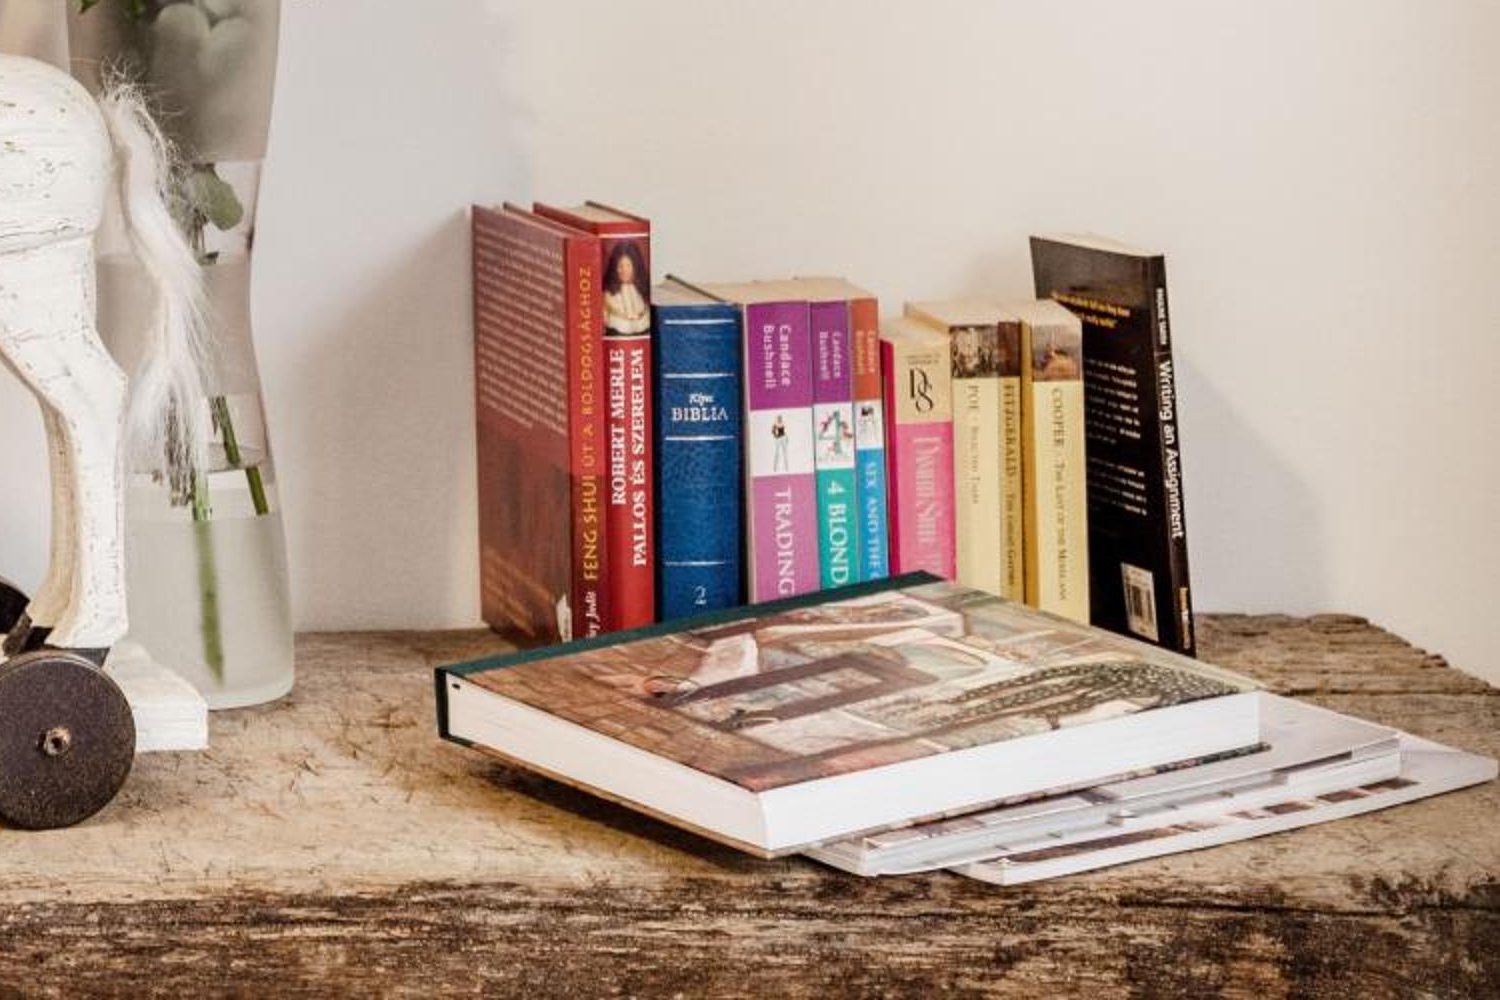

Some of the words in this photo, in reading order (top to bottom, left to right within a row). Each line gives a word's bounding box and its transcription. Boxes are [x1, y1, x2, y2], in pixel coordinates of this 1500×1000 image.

[578, 267, 594, 415] BOLDOGSÁGHOZ
[763, 325, 777, 389] Bushnell
[780, 325, 792, 387] Candace
[609, 349, 625, 419] MERLE
[631, 348, 645, 455] SZERELEM
[672, 407, 728, 421] BIBLIA
[1159, 360, 1175, 421] Writing
[583, 423, 593, 437] A
[1163, 423, 1175, 444] an
[611, 423, 626, 504] ROBERT
[629, 459, 645, 485] ÉS
[827, 480, 846, 495] 4
[1165, 449, 1184, 538] Assignment
[581, 475, 597, 523] SHUI
[632, 491, 647, 566] PALLOS
[867, 498, 879, 533] AND
[583, 529, 598, 580] FENG
[774, 486, 795, 595] TRADING
[828, 503, 849, 587] BLOND
[868, 536, 880, 569] THE
[694, 585, 707, 605] 2
